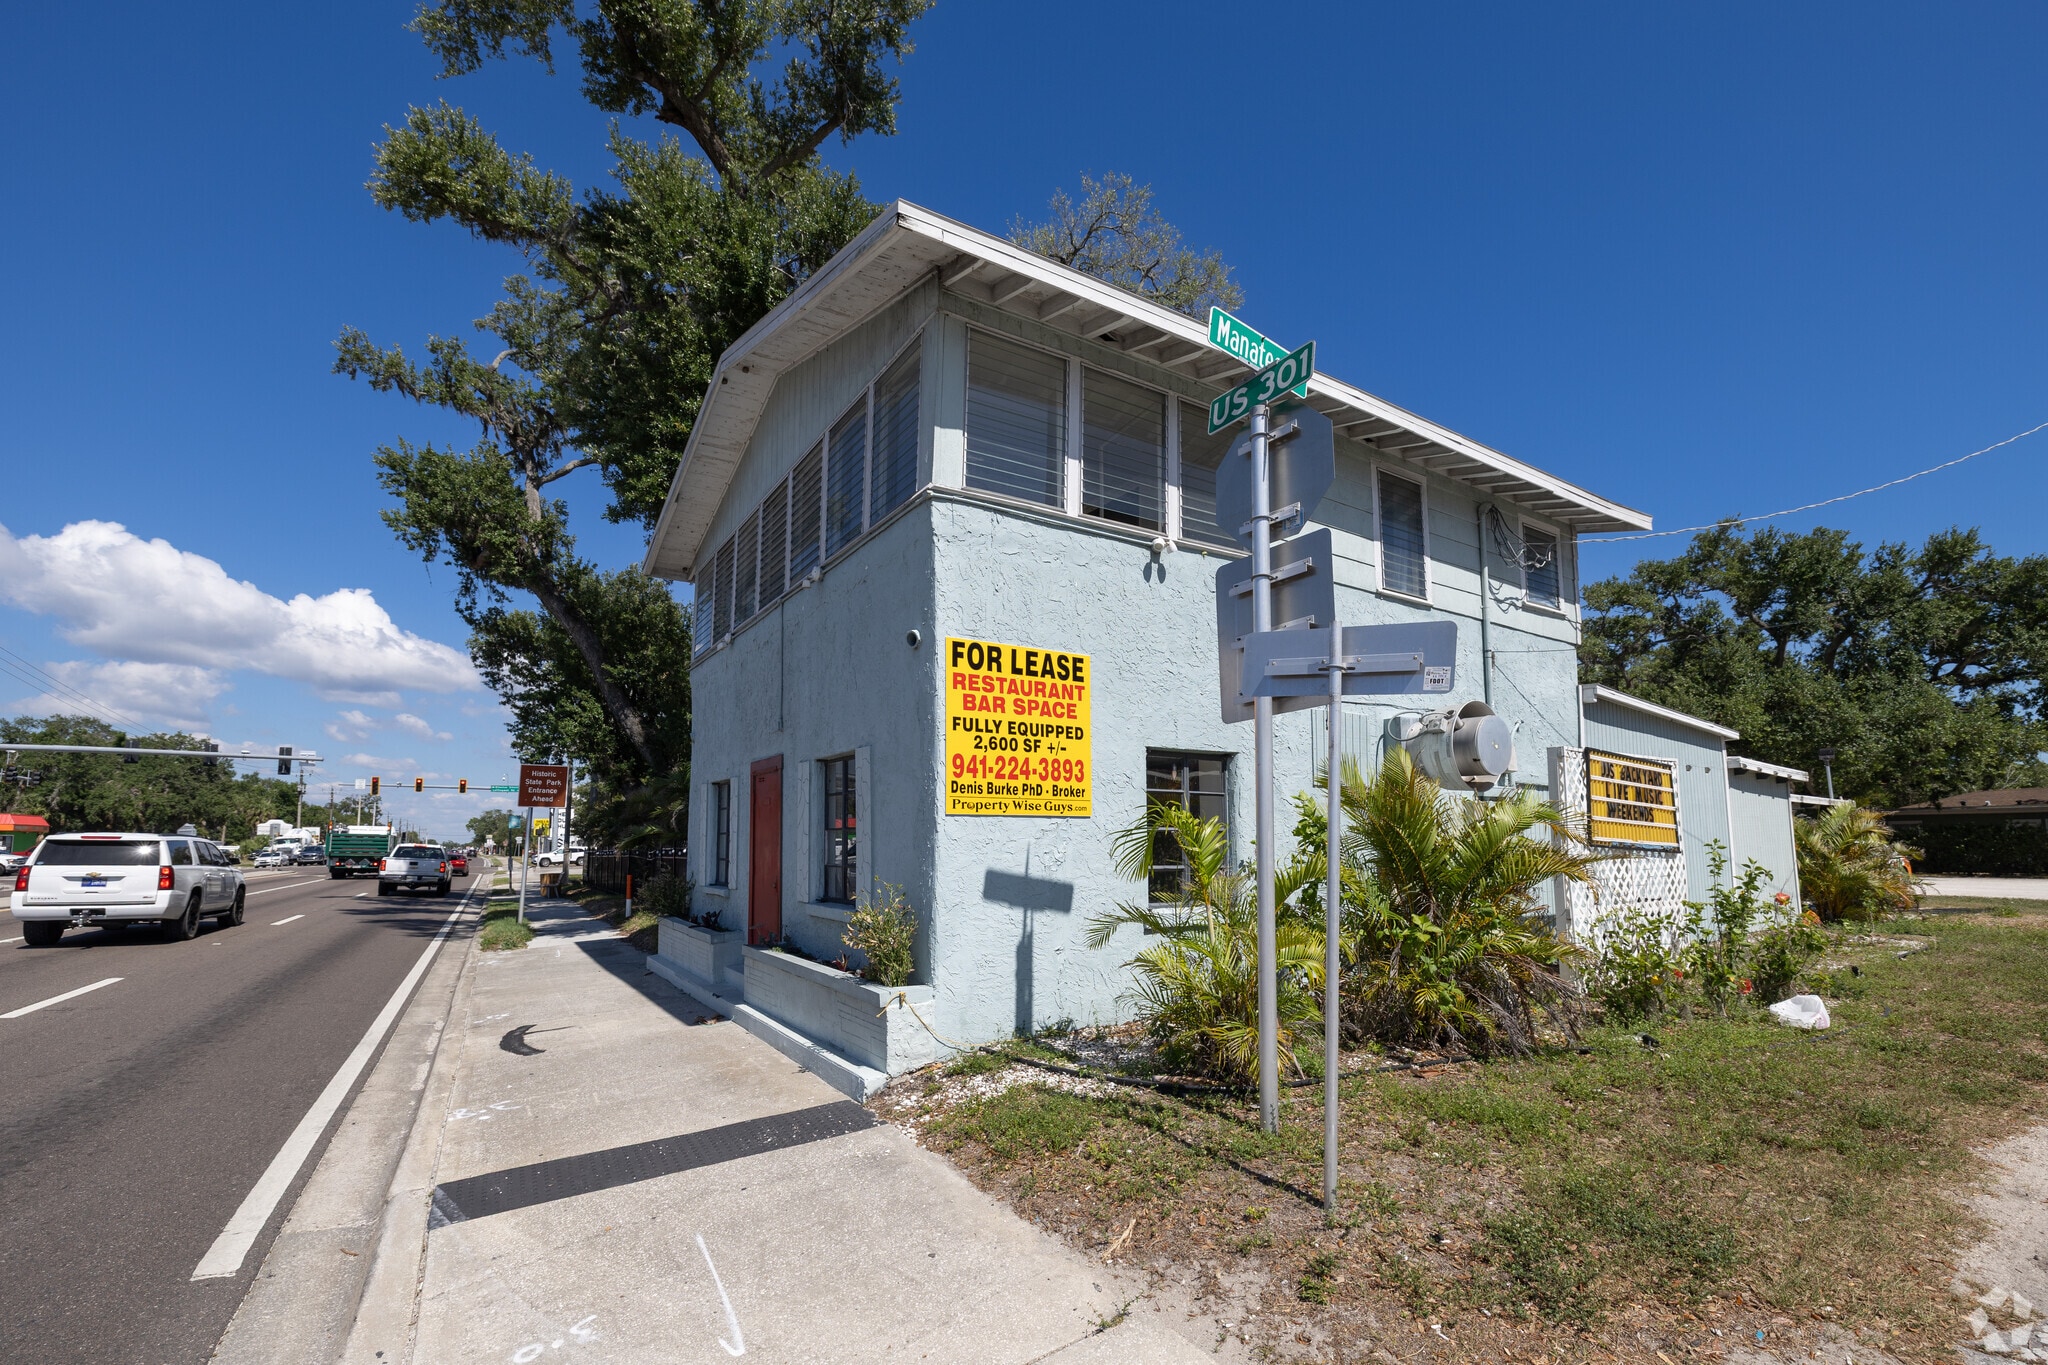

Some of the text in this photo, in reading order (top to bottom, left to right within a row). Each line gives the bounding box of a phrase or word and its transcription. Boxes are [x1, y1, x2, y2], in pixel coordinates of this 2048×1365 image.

[1213, 348, 1309, 425] US 301
[952, 640, 1084, 682] FOR LEASE
[952, 672, 1085, 701] RESTAURANT
[963, 694, 1077, 719] BAR SPACE
[952, 717, 1083, 740] FULLY EQUIPPED
[974, 736, 1066, 755] 2,600 SF +/-
[952, 753, 1084, 783] 941-224-3893
[1620, 764, 1662, 787] BACKYARD
[951, 781, 1085, 798] Denis Burke PhD Broker
[1606, 781, 1663, 806] LIVE MUSIC
[952, 799, 1010, 813] Property
[1013, 800, 1041, 811] Wise
[1607, 801, 1654, 822] WEEKENDS
